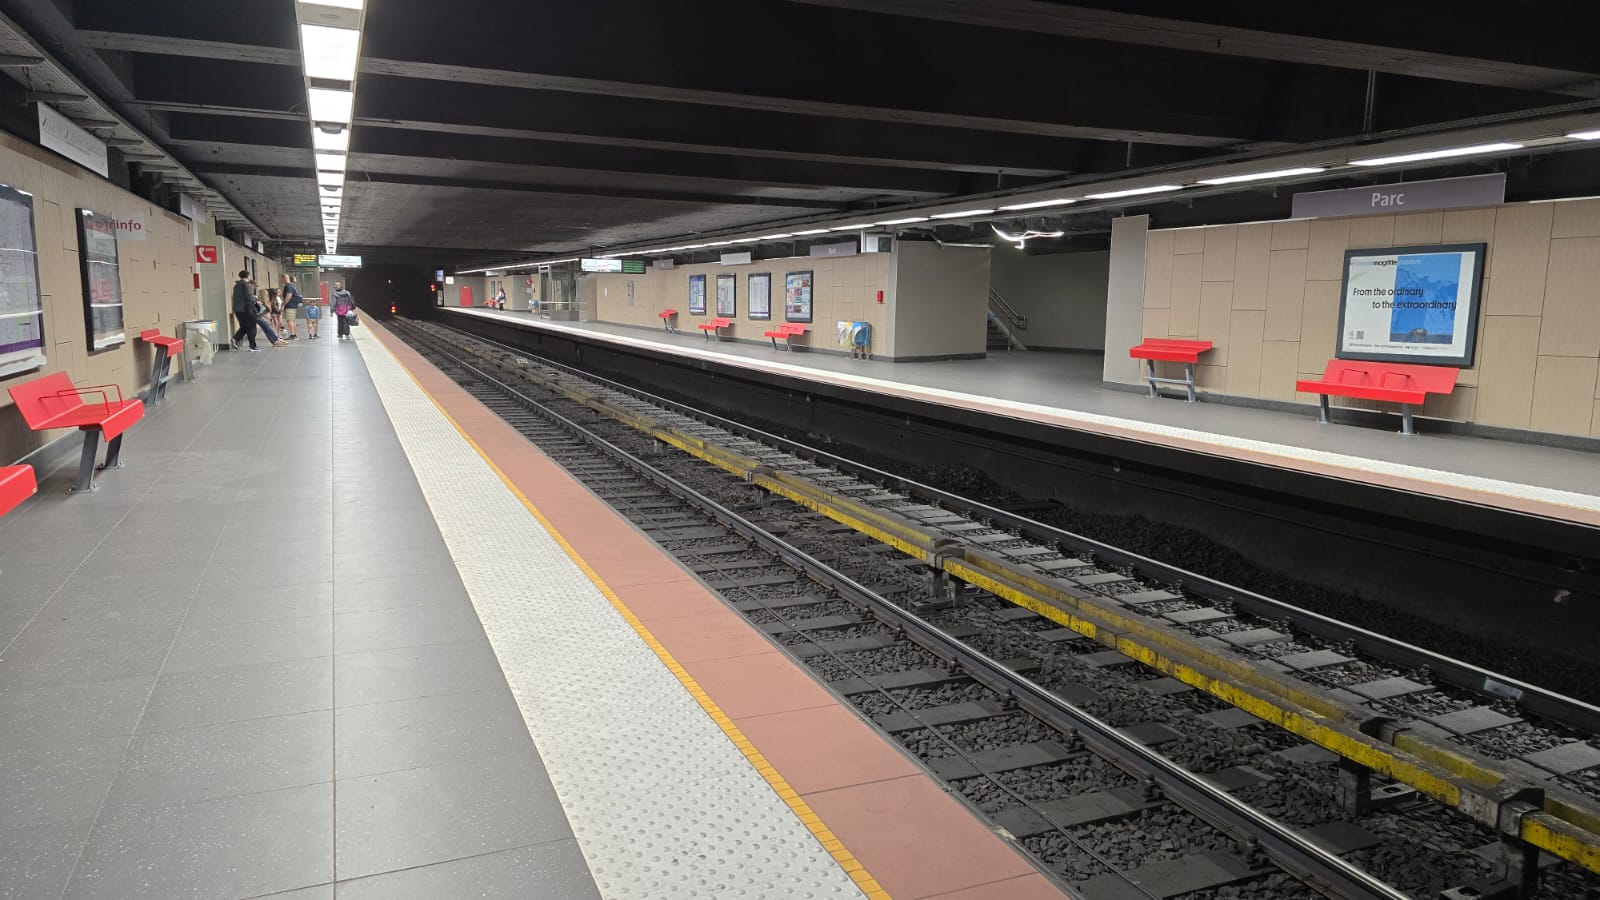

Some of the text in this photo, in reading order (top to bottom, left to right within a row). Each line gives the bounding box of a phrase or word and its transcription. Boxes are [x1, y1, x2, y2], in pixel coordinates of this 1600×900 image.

[1371, 192, 1405, 208] Parc
[115, 219, 142, 233] info
[1353, 287, 1424, 297] From the ordinary
[1372, 300, 1457, 311] to the extraordinary
